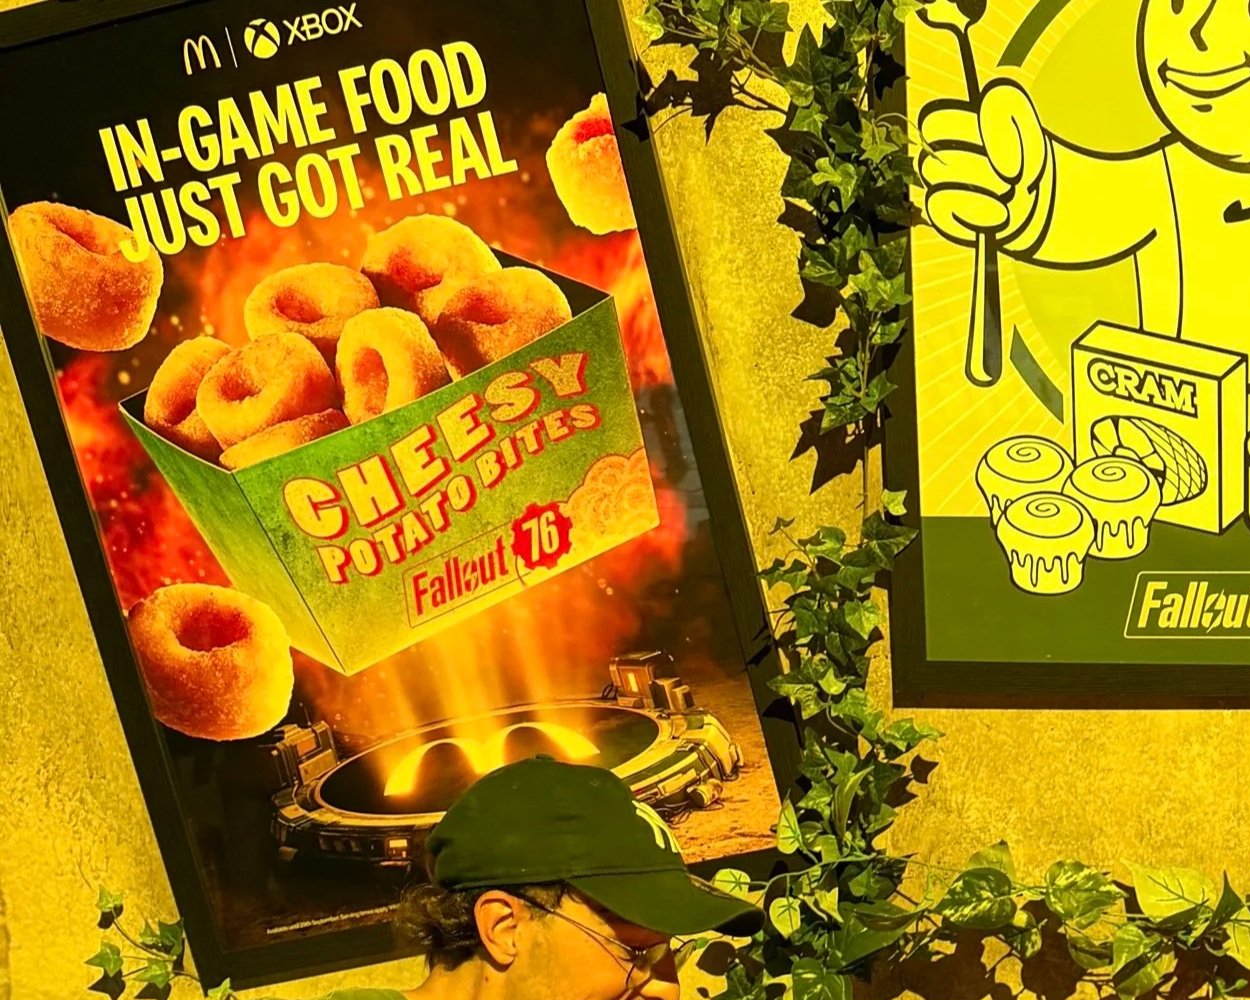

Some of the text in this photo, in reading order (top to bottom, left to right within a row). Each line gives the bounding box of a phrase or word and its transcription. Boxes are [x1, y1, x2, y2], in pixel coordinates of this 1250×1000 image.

[283, 4, 363, 45] XBOX
[99, 40, 487, 192] IN-GAME FOOD
[119, 111, 518, 263] JUST GOT REAL
[282, 352, 590, 540] CHEESY
[1087, 357, 1198, 419] CRAM
[317, 402, 601, 584] POTATO BITES
[411, 510, 560, 616] Fallout 76
